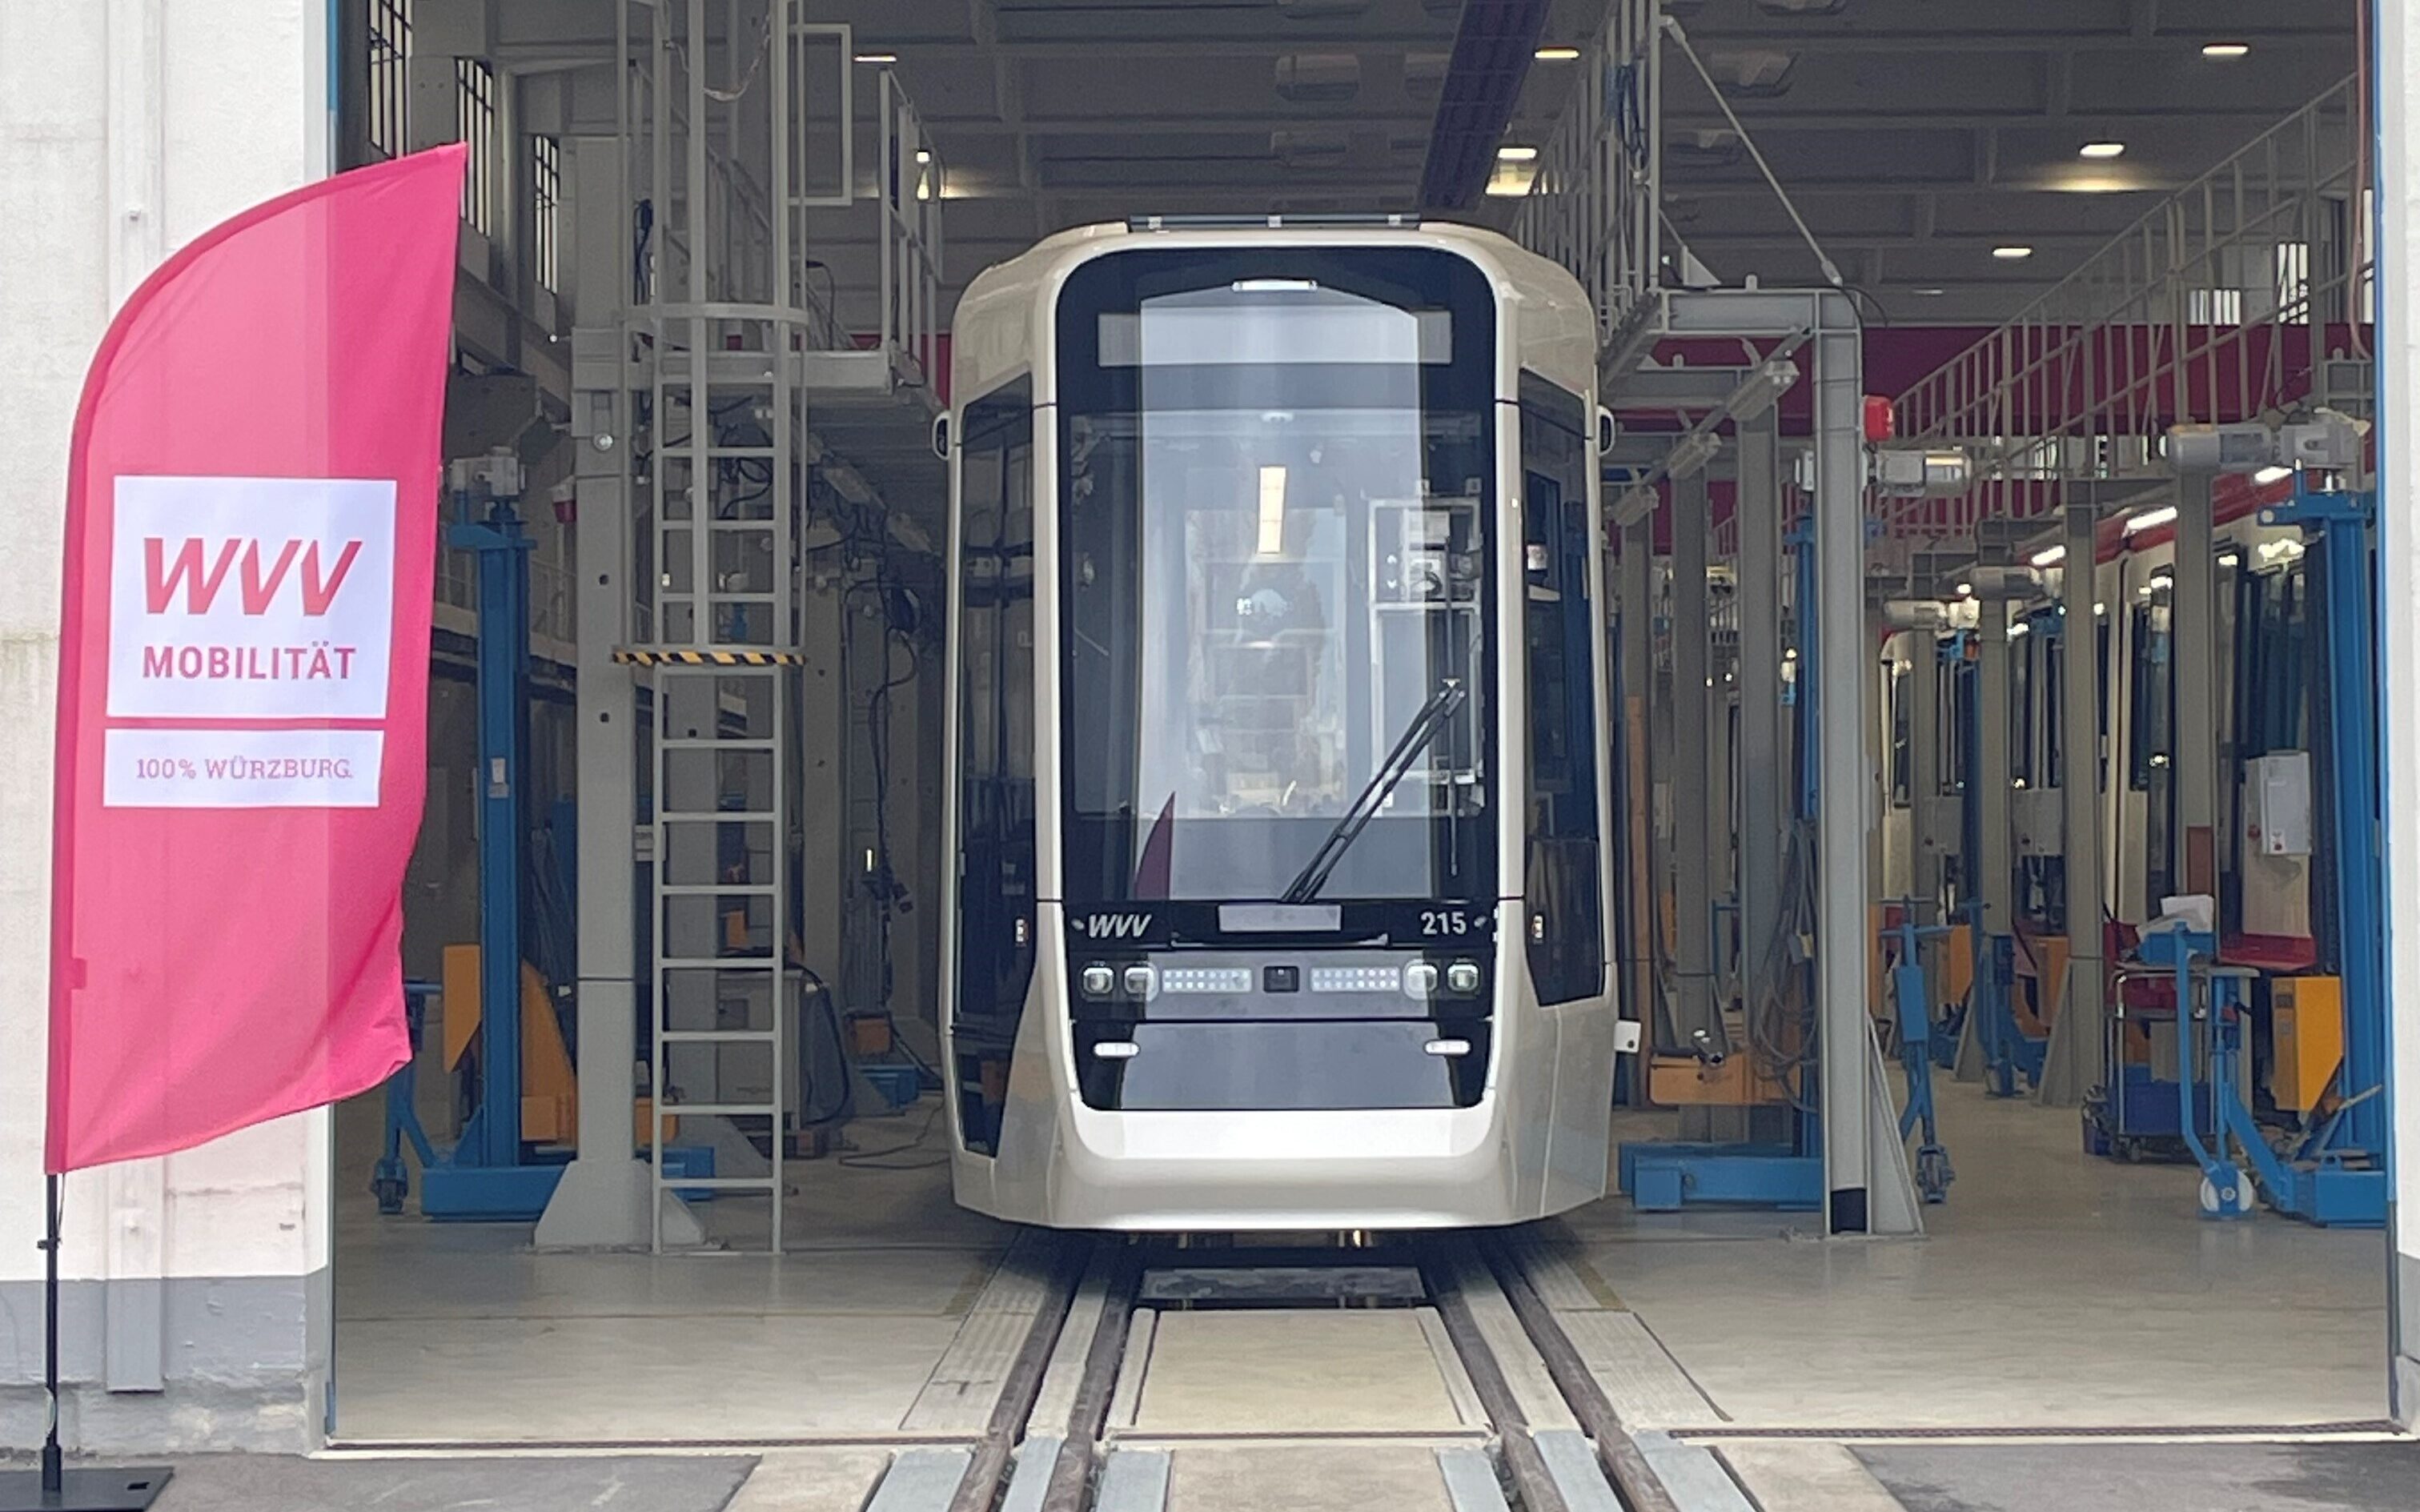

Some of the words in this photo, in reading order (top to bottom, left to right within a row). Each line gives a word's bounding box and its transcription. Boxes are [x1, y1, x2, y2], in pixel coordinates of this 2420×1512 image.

[144, 538, 362, 616] WVV
[142, 641, 356, 680] MOBILITÄT
[137, 759, 197, 779] 100%
[1089, 913, 1153, 938] WVV
[1420, 911, 1467, 935] 215
